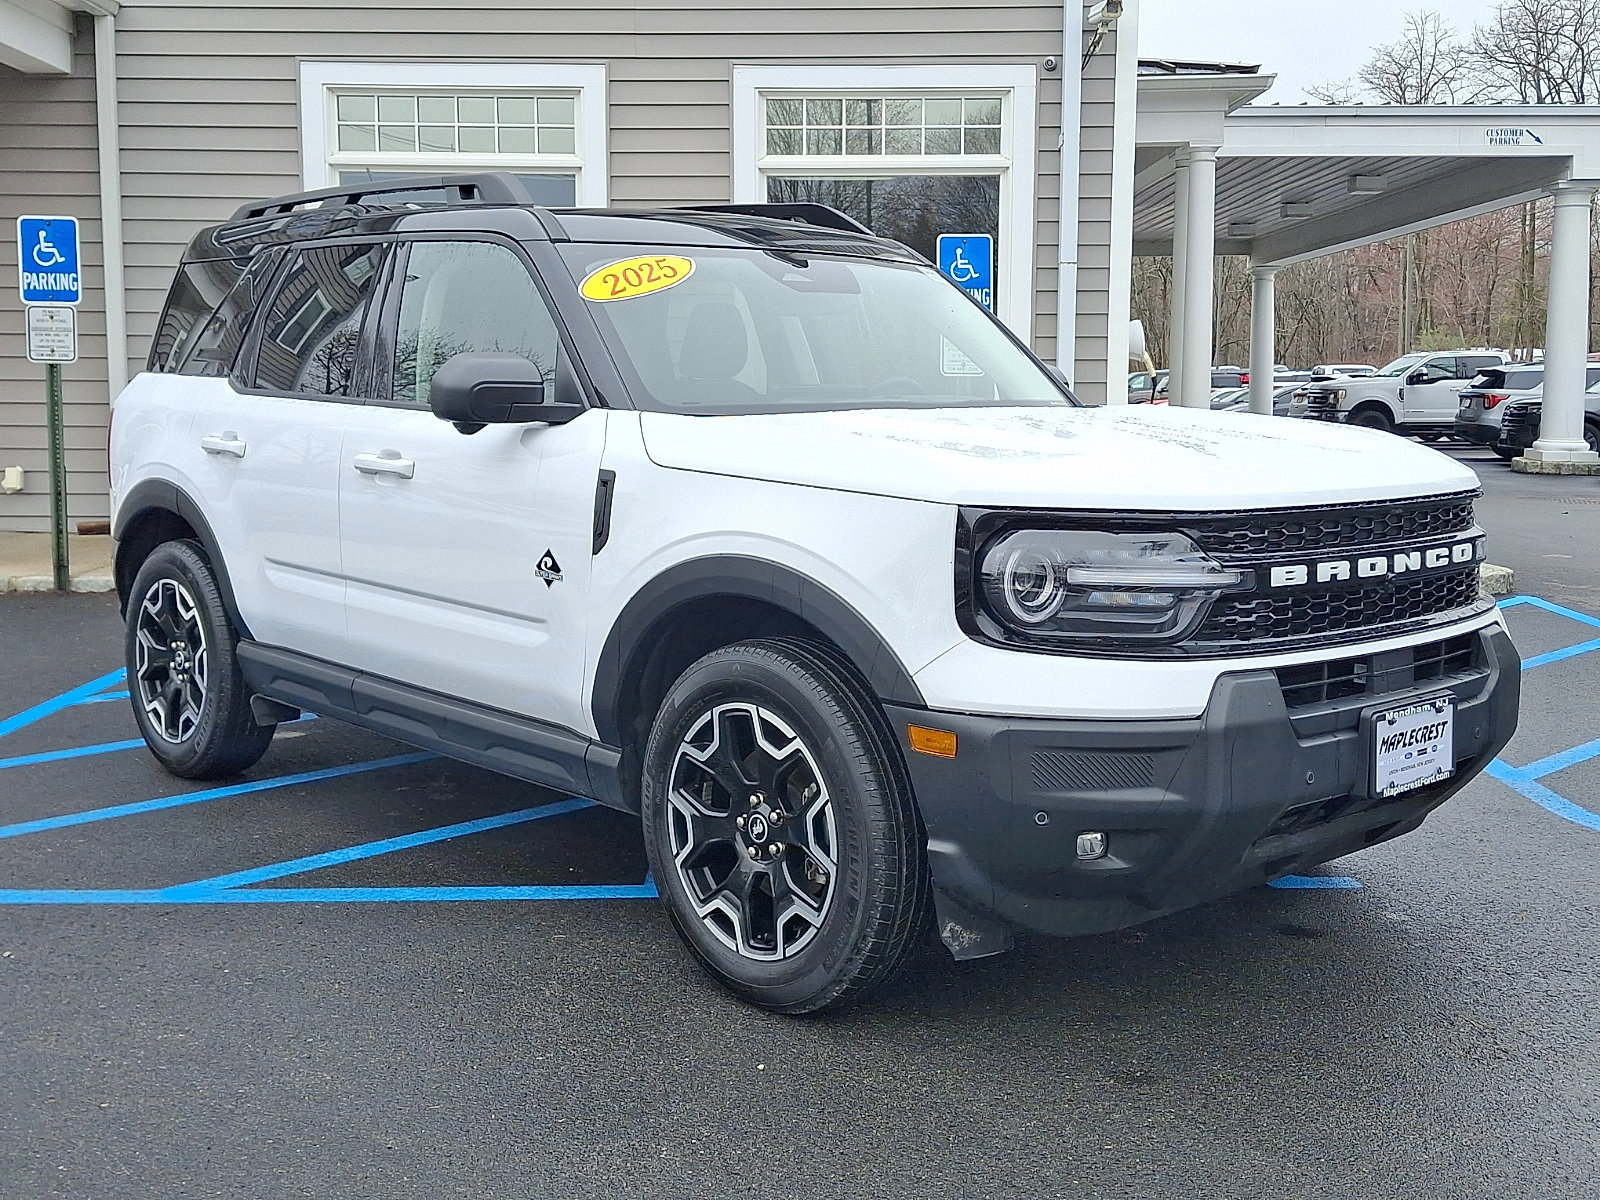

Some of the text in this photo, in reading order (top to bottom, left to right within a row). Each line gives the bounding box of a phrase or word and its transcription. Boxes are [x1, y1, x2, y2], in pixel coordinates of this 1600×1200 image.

[1486, 129, 1524, 137] CUSTOMER
[1489, 137, 1521, 145] PARKING
[23, 272, 78, 291] PARKING
[602, 258, 678, 296] 2025
[1270, 542, 1473, 587] BRONCO
[1435, 698, 1449, 708] NJ
[1379, 721, 1448, 755] MAPLECREST
[1383, 770, 1450, 797] MaplecrestFord.com
